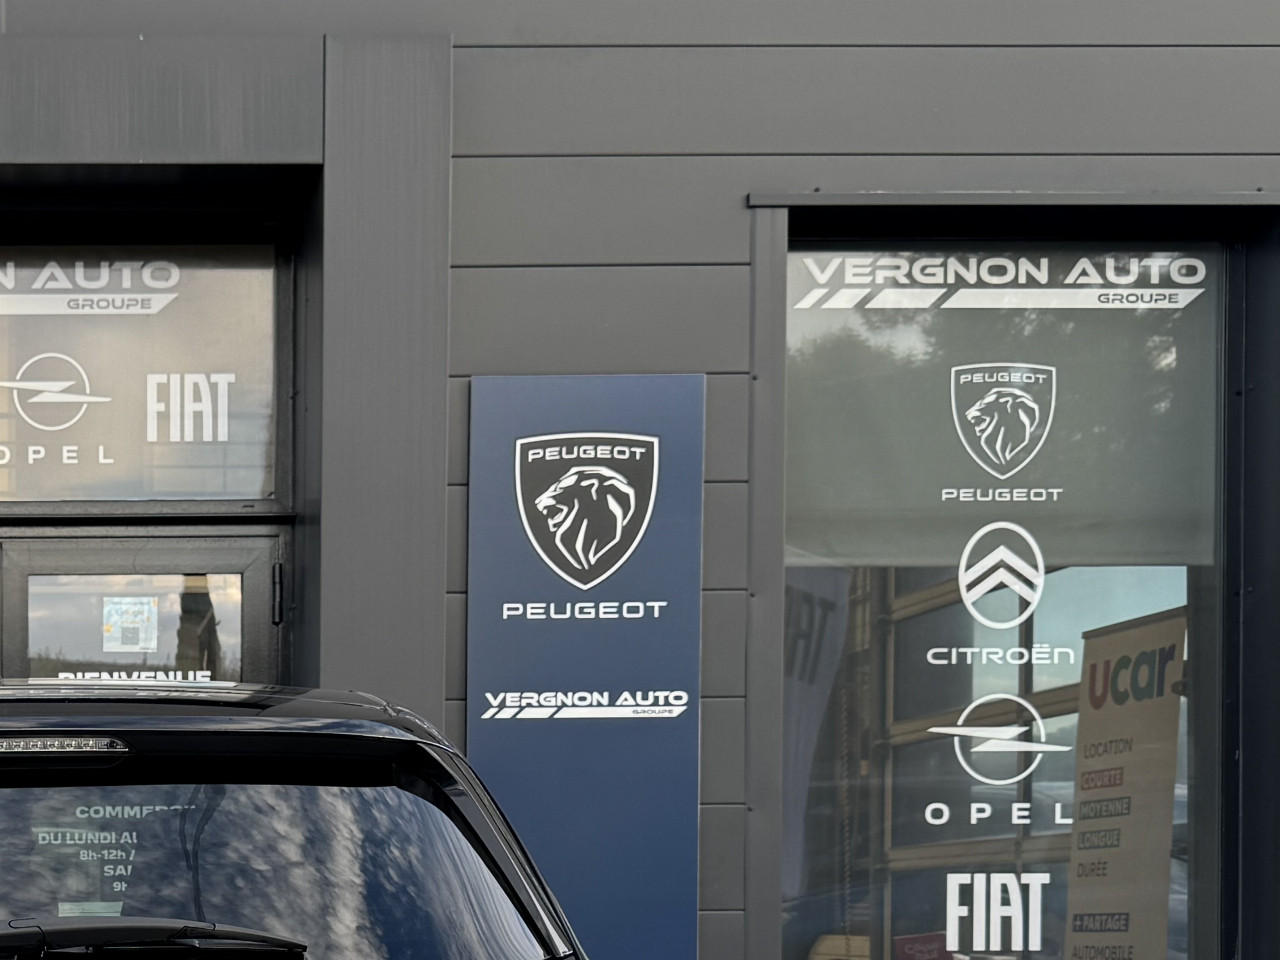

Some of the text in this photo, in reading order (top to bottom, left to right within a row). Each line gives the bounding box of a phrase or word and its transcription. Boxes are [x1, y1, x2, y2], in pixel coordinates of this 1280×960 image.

[31, 261, 181, 290] AUTO
[802, 257, 1207, 285] VERGNON AUTO
[66, 297, 152, 310] GROUPE
[1097, 292, 1180, 304] GROUPE
[959, 372, 1047, 385] PEUGEOT
[146, 373, 236, 443] FIAT
[528, 445, 646, 462] PEUGEOT
[941, 488, 1064, 502] PEUGEOT
[502, 601, 668, 620] PEUGEOT
[484, 690, 689, 707] VERGNON AUTO
[1083, 738, 1133, 759] LOCATION
[1082, 769, 1123, 789] COURTE
[924, 802, 1074, 825] OPEL
[1080, 798, 1130, 819] MOYENNE
[38, 832, 61, 845] DU
[66, 832, 116, 844] LUNDI
[1079, 830, 1120, 849] LONGUE
[945, 872, 1051, 952] FIAT
[1072, 945, 1134, 960] AUTOMOBILE
